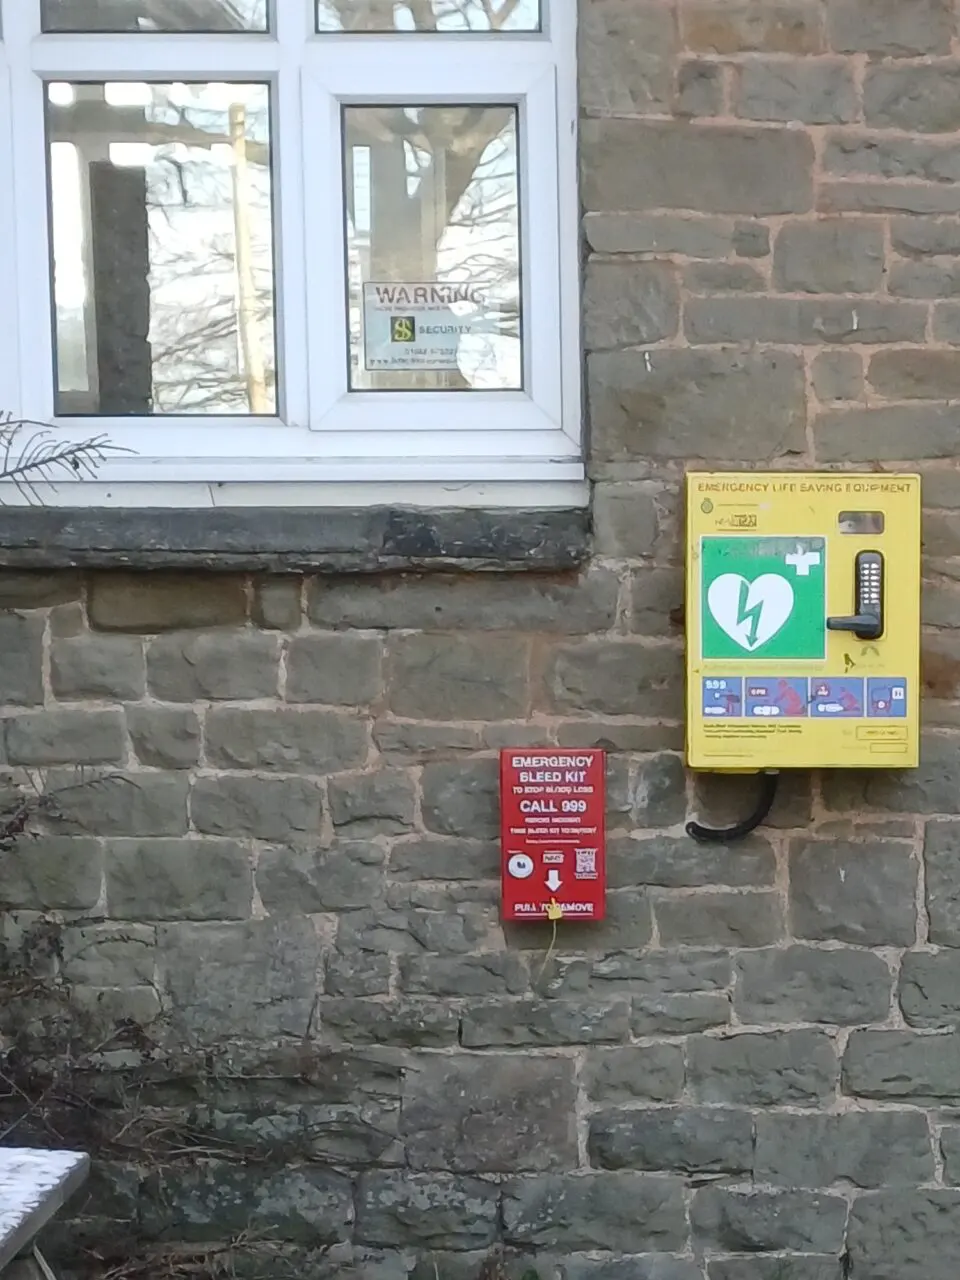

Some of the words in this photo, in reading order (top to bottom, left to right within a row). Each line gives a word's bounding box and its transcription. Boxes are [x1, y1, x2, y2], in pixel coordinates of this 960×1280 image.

[376, 286, 485, 304] WARNING
[419, 325, 472, 334] SECURITY
[698, 483, 768, 493] EMERGENCY
[773, 483, 797, 493] LIFE
[800, 483, 843, 493] SAVING
[846, 483, 911, 493] EQUIPMENT
[705, 680, 727, 689] 999
[512, 755, 594, 768] EMERGENCY
[519, 771, 561, 782] BLEED
[565, 771, 587, 783] KIT
[512, 786, 523, 794] TO
[520, 800, 558, 812] CALL
[561, 800, 587, 812] 999
[514, 903, 536, 912] PULL
